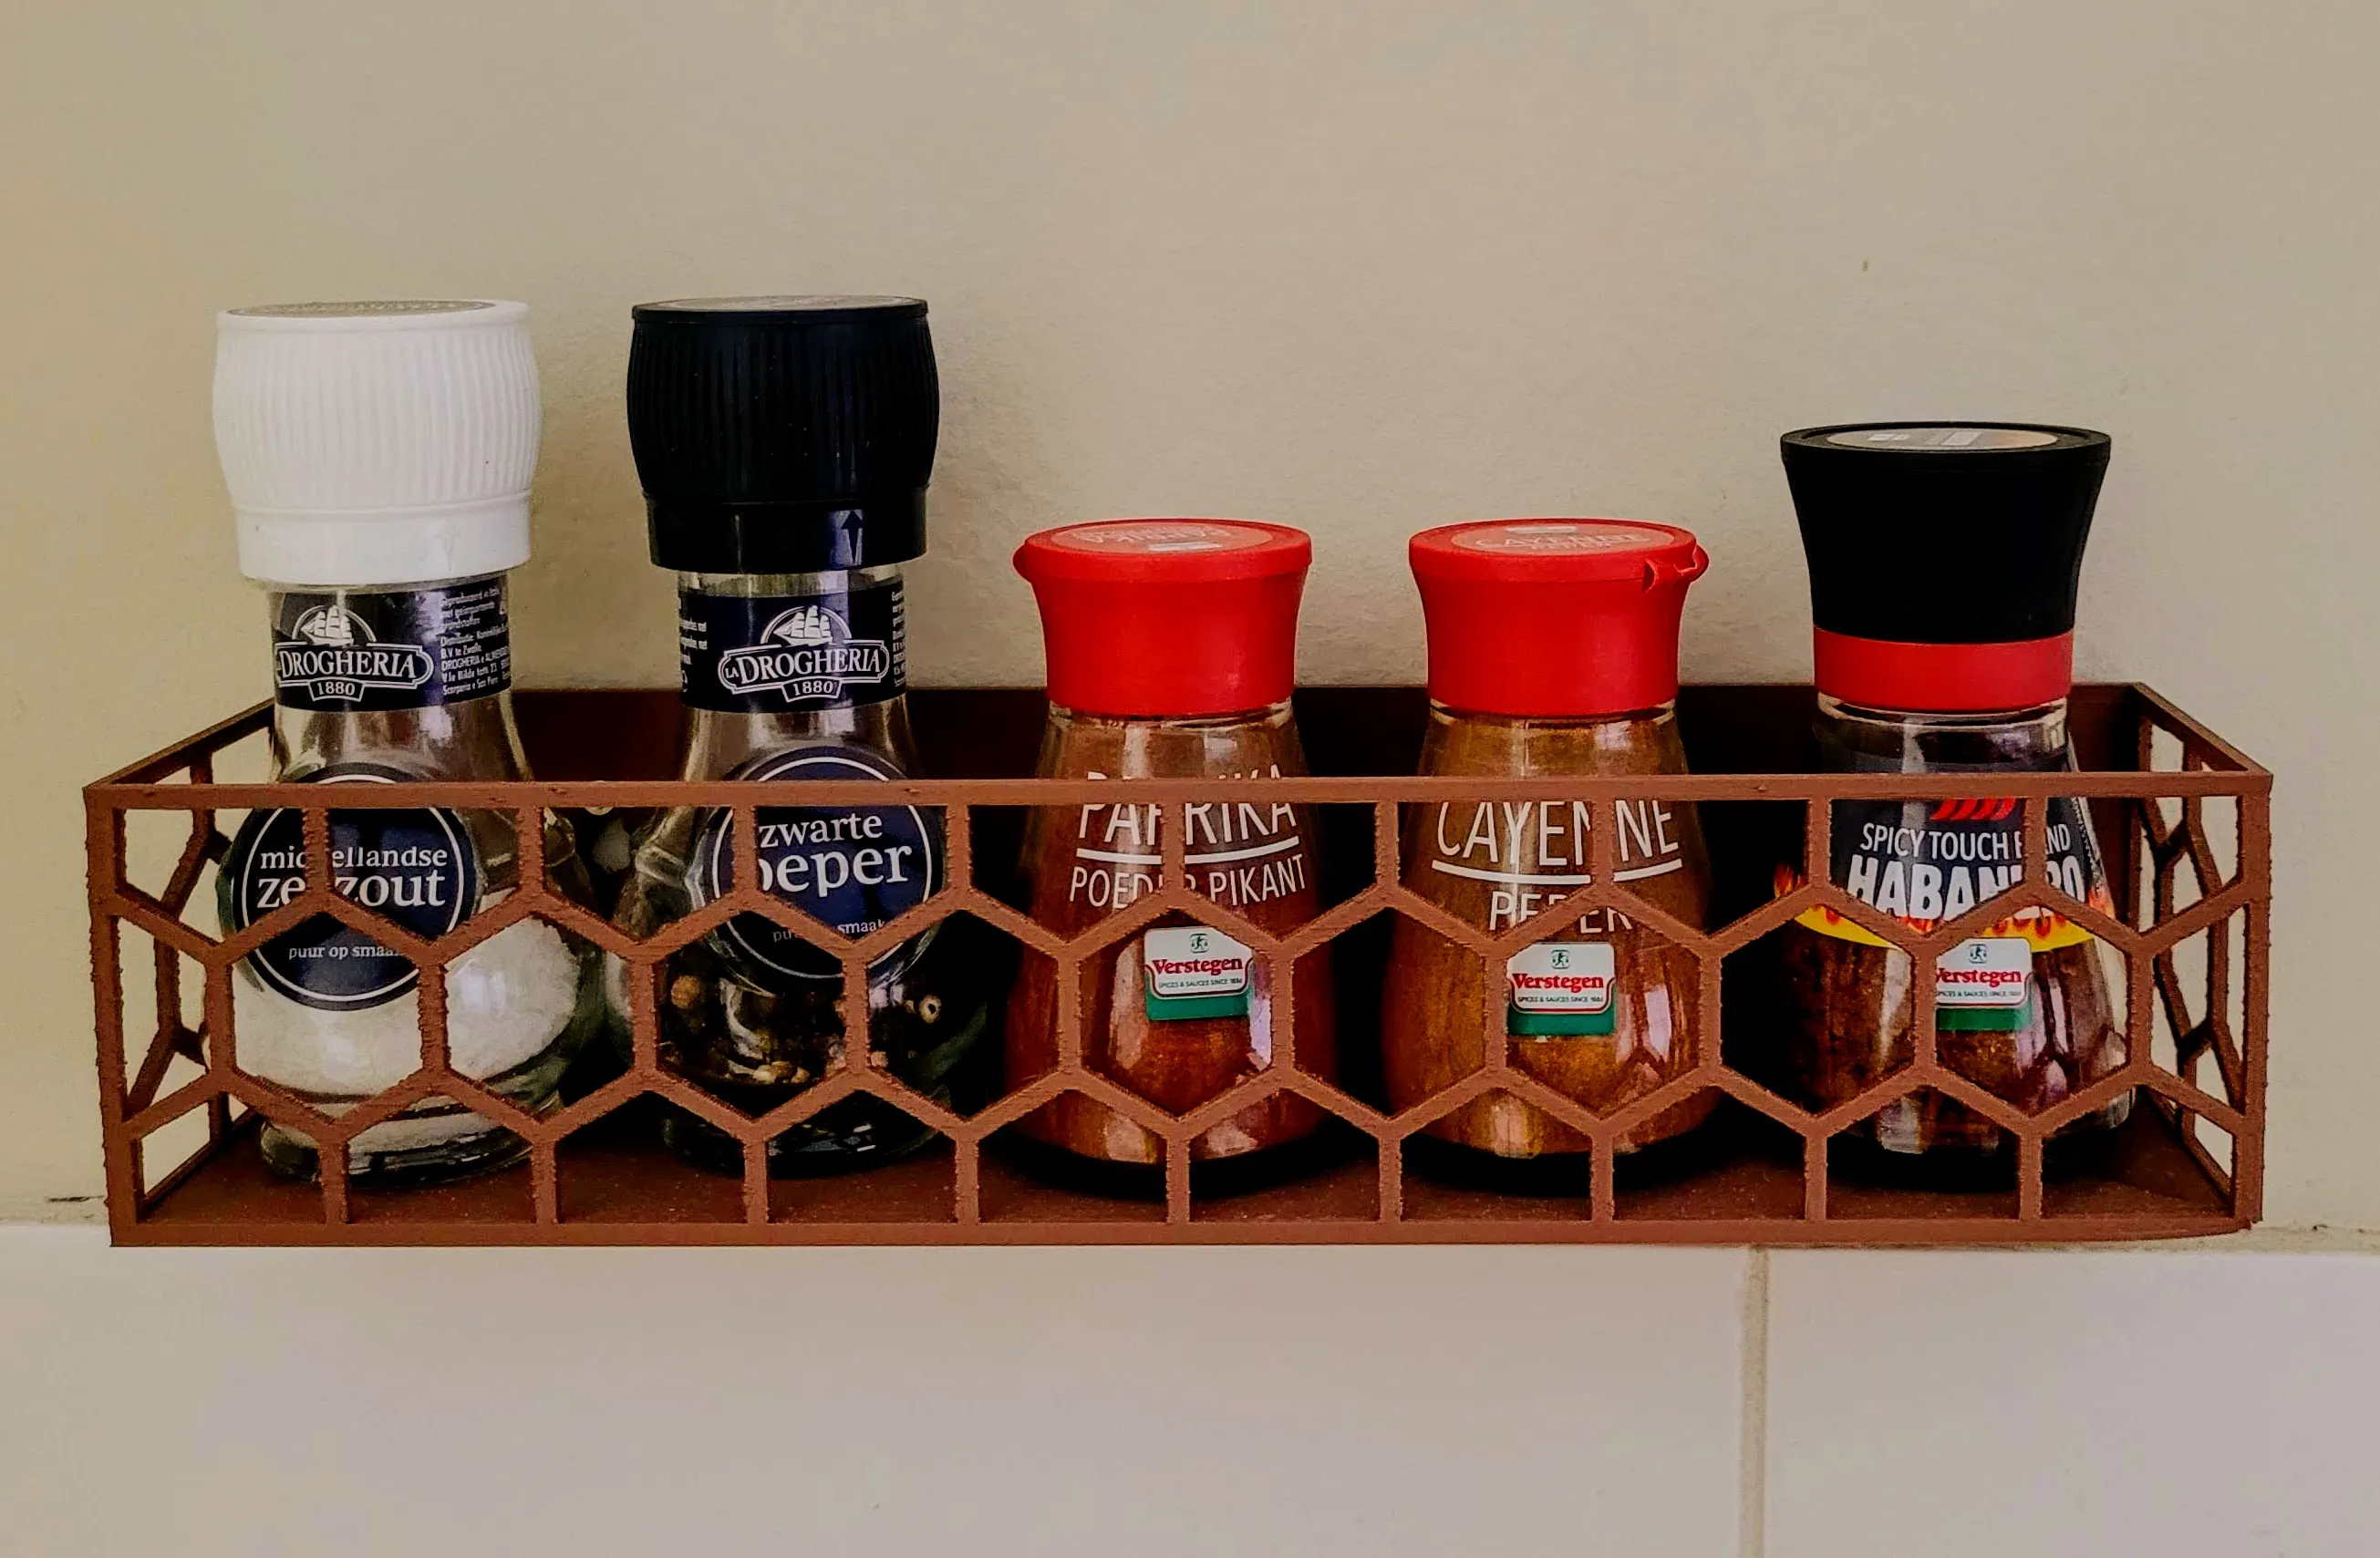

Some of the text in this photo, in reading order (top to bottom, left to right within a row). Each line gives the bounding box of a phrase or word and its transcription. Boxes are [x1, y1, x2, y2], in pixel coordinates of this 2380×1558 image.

[279, 650, 417, 679] DROGHERIA
[725, 648, 881, 685] LA DROGHERIA
[317, 681, 356, 696] 1880
[792, 680, 834, 696] 1880
[759, 812, 884, 849] zwarte
[1859, 822, 1925, 858] SPICY
[1929, 831, 2010, 861] TOUCH
[260, 845, 448, 870] miellandse
[256, 869, 446, 909] zezout
[1069, 853, 1306, 909] POED PIKANT
[1489, 891, 1634, 934] PEER
[288, 945, 398, 961] puur op smaa
[1152, 957, 1244, 976] Verstegen
[1512, 973, 1604, 994] Verstegen
